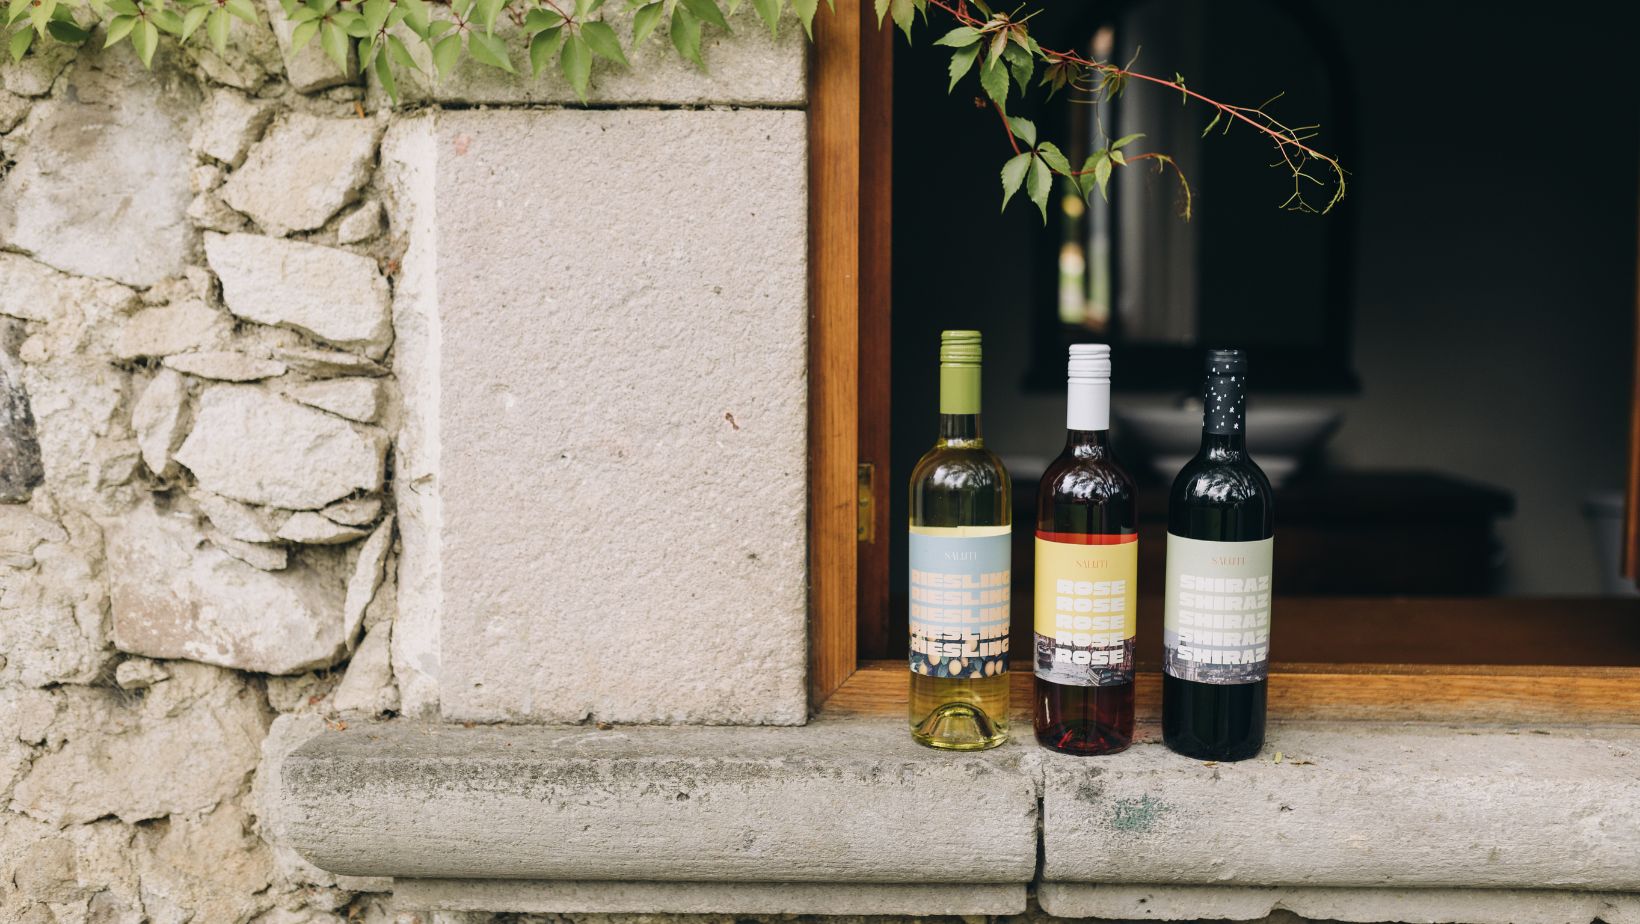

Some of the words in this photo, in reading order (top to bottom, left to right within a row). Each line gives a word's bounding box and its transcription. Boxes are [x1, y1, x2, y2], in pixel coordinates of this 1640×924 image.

[1056, 579, 1126, 596] ROSE
[1180, 574, 1269, 593] SHIRAZ
[1055, 596, 1126, 613] ROSE
[1179, 591, 1269, 611] SHIRAZ
[1055, 613, 1125, 630] ROSE
[1178, 609, 1268, 629] SHIRAZ
[1055, 630, 1125, 647] ROSE
[1178, 627, 1267, 647] SHIRAZ
[1055, 648, 1124, 665] ROSE
[1177, 645, 1267, 665] SHIRAZ
